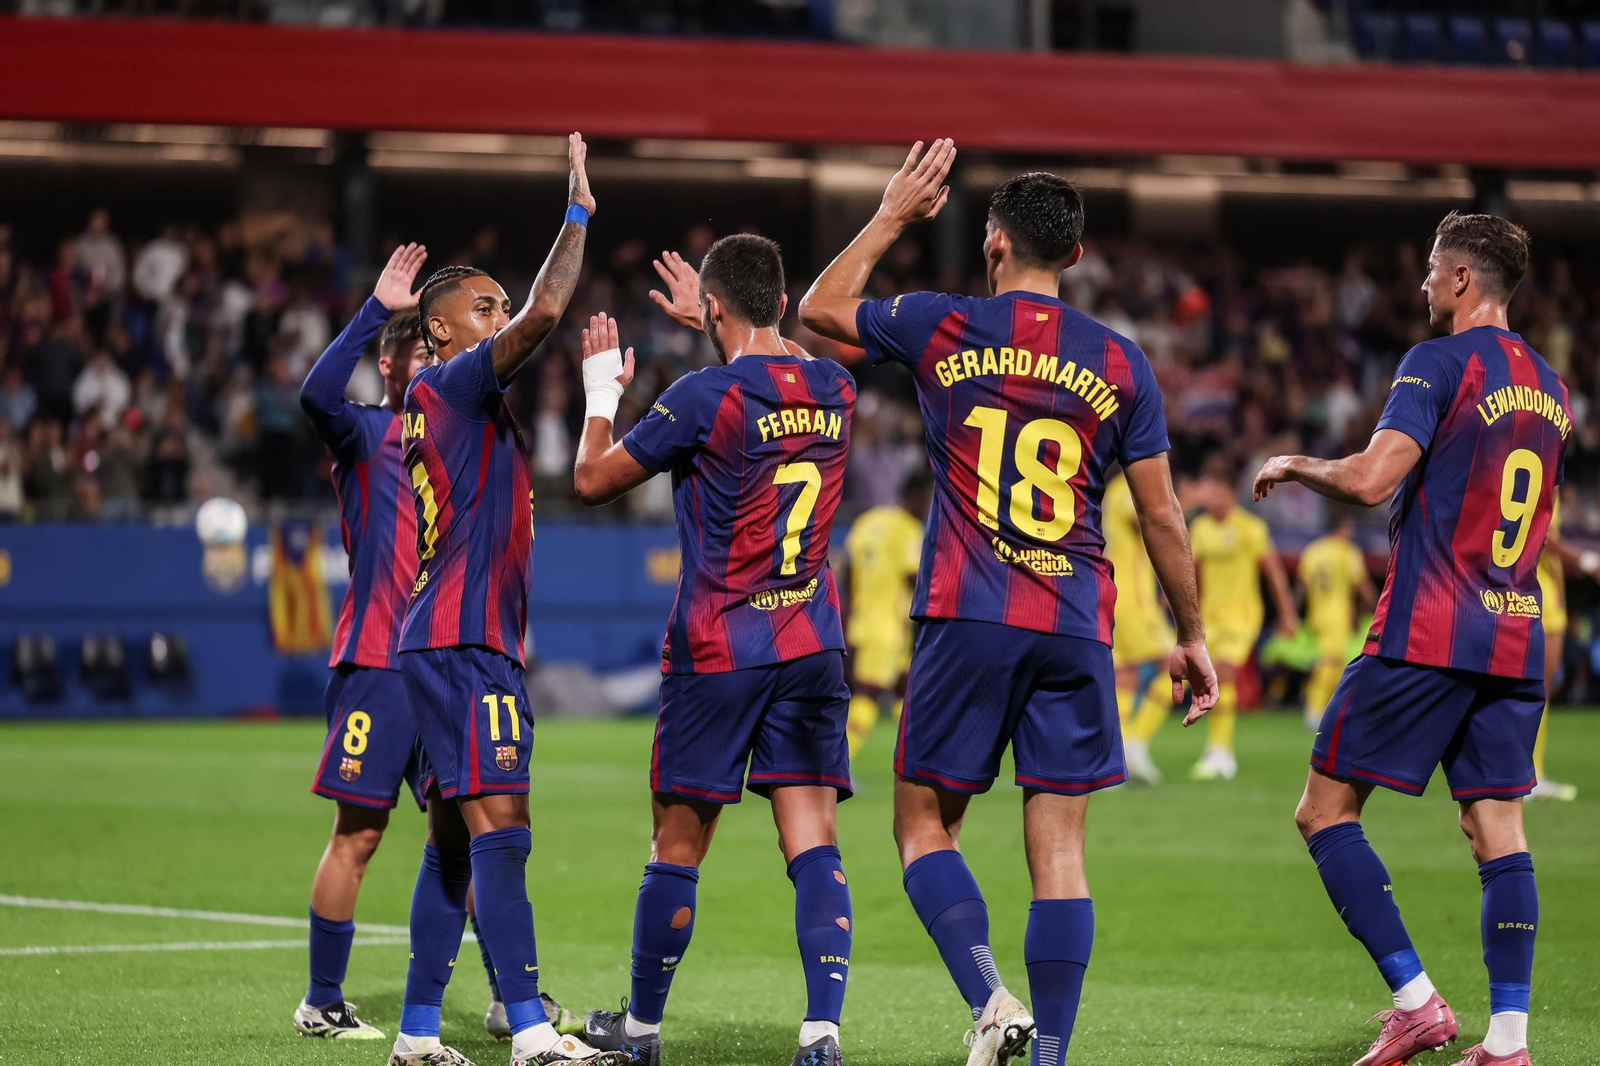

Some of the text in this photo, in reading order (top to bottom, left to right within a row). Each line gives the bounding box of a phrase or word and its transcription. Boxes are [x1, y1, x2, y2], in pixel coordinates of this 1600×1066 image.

[935, 346, 1120, 422] GERARD MARTÍN
[1422, 380, 1432, 389] tv
[756, 408, 843, 443] FERRAN
[963, 405, 1082, 542] 18
[772, 461, 823, 576] 7
[1491, 448, 1544, 568] 9
[342, 710, 372, 756] 8
[481, 694, 521, 742] 11
